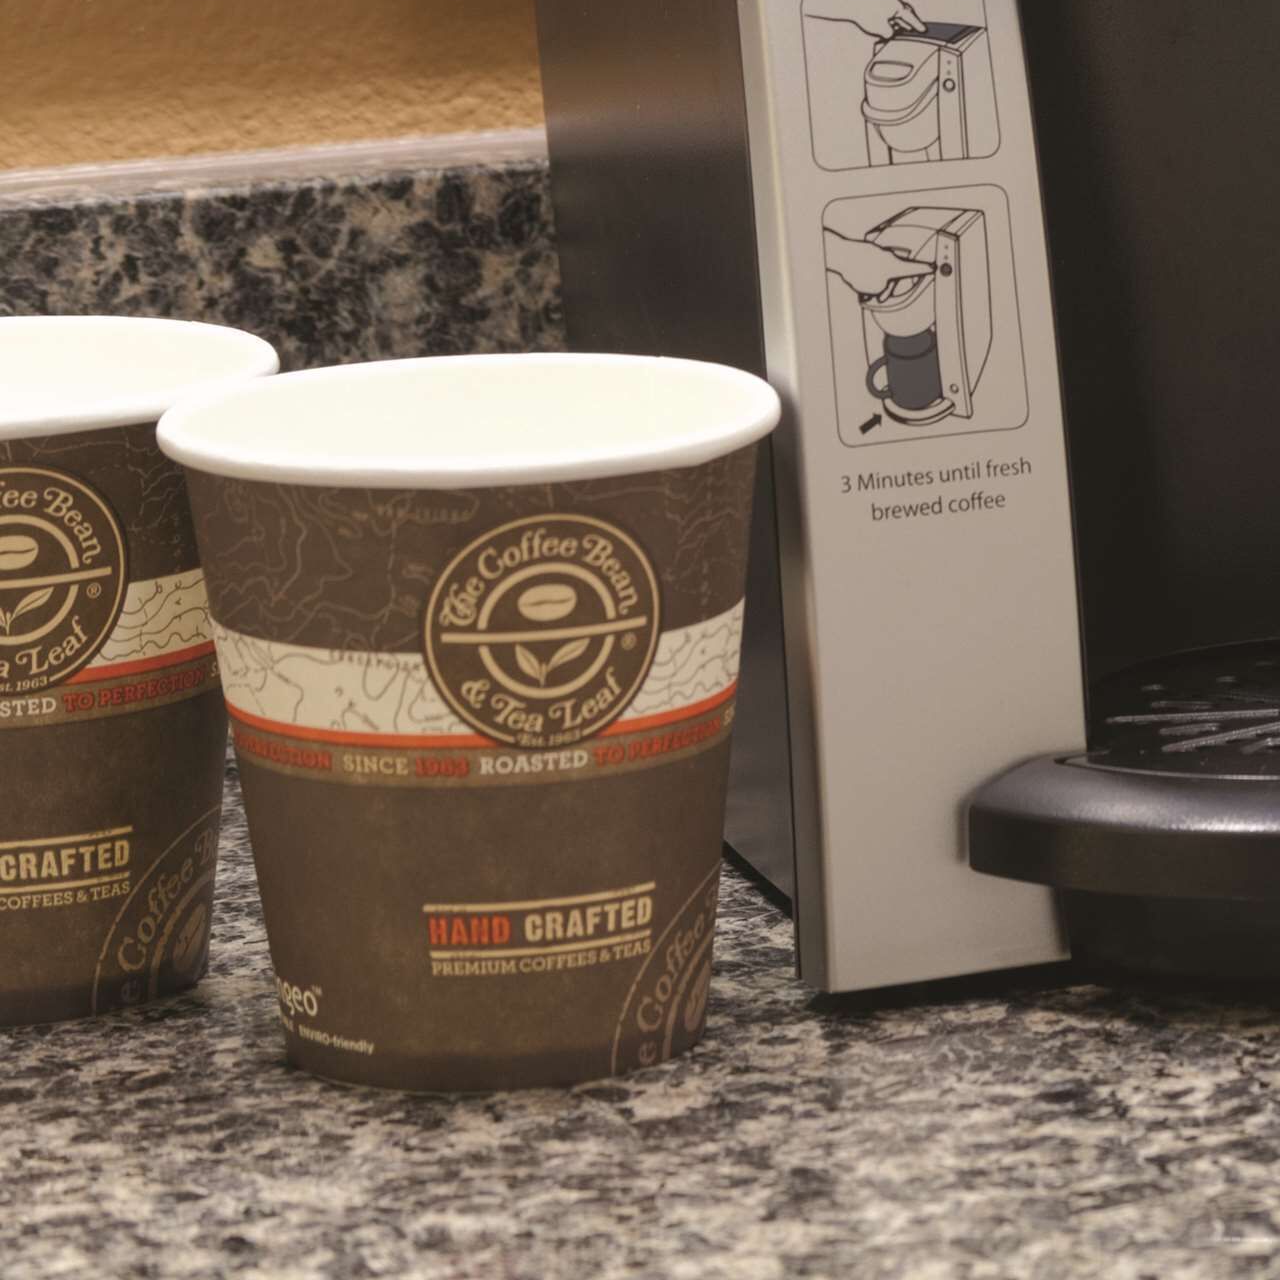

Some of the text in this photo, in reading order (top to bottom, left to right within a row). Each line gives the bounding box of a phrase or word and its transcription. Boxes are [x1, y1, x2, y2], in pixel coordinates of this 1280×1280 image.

[840, 457, 1032, 494] 3 Minutes until fresh
[43, 486, 101, 564] Bean
[871, 491, 1006, 521] brewed coffee
[440, 528, 638, 627] The Coffee Bean
[16, 616, 88, 677] Leaf
[16, 676, 48, 691] 1963
[63, 692, 94, 714] TO
[100, 669, 205, 707] PERFECTION
[461, 666, 622, 733] & Tea Leaf
[343, 754, 409, 776] SINCE
[415, 756, 470, 778] 1963
[480, 750, 588, 776] ROASTED
[592, 743, 625, 768] TO
[627, 715, 721, 762] PERFECTION
[0, 840, 130, 881] CRAFTED
[76, 890, 88, 903] &
[90, 881, 131, 901] TEAS
[428, 895, 653, 946] HAND CRAFTED
[432, 939, 651, 977] PREMIUM COFFEES & TEAS
